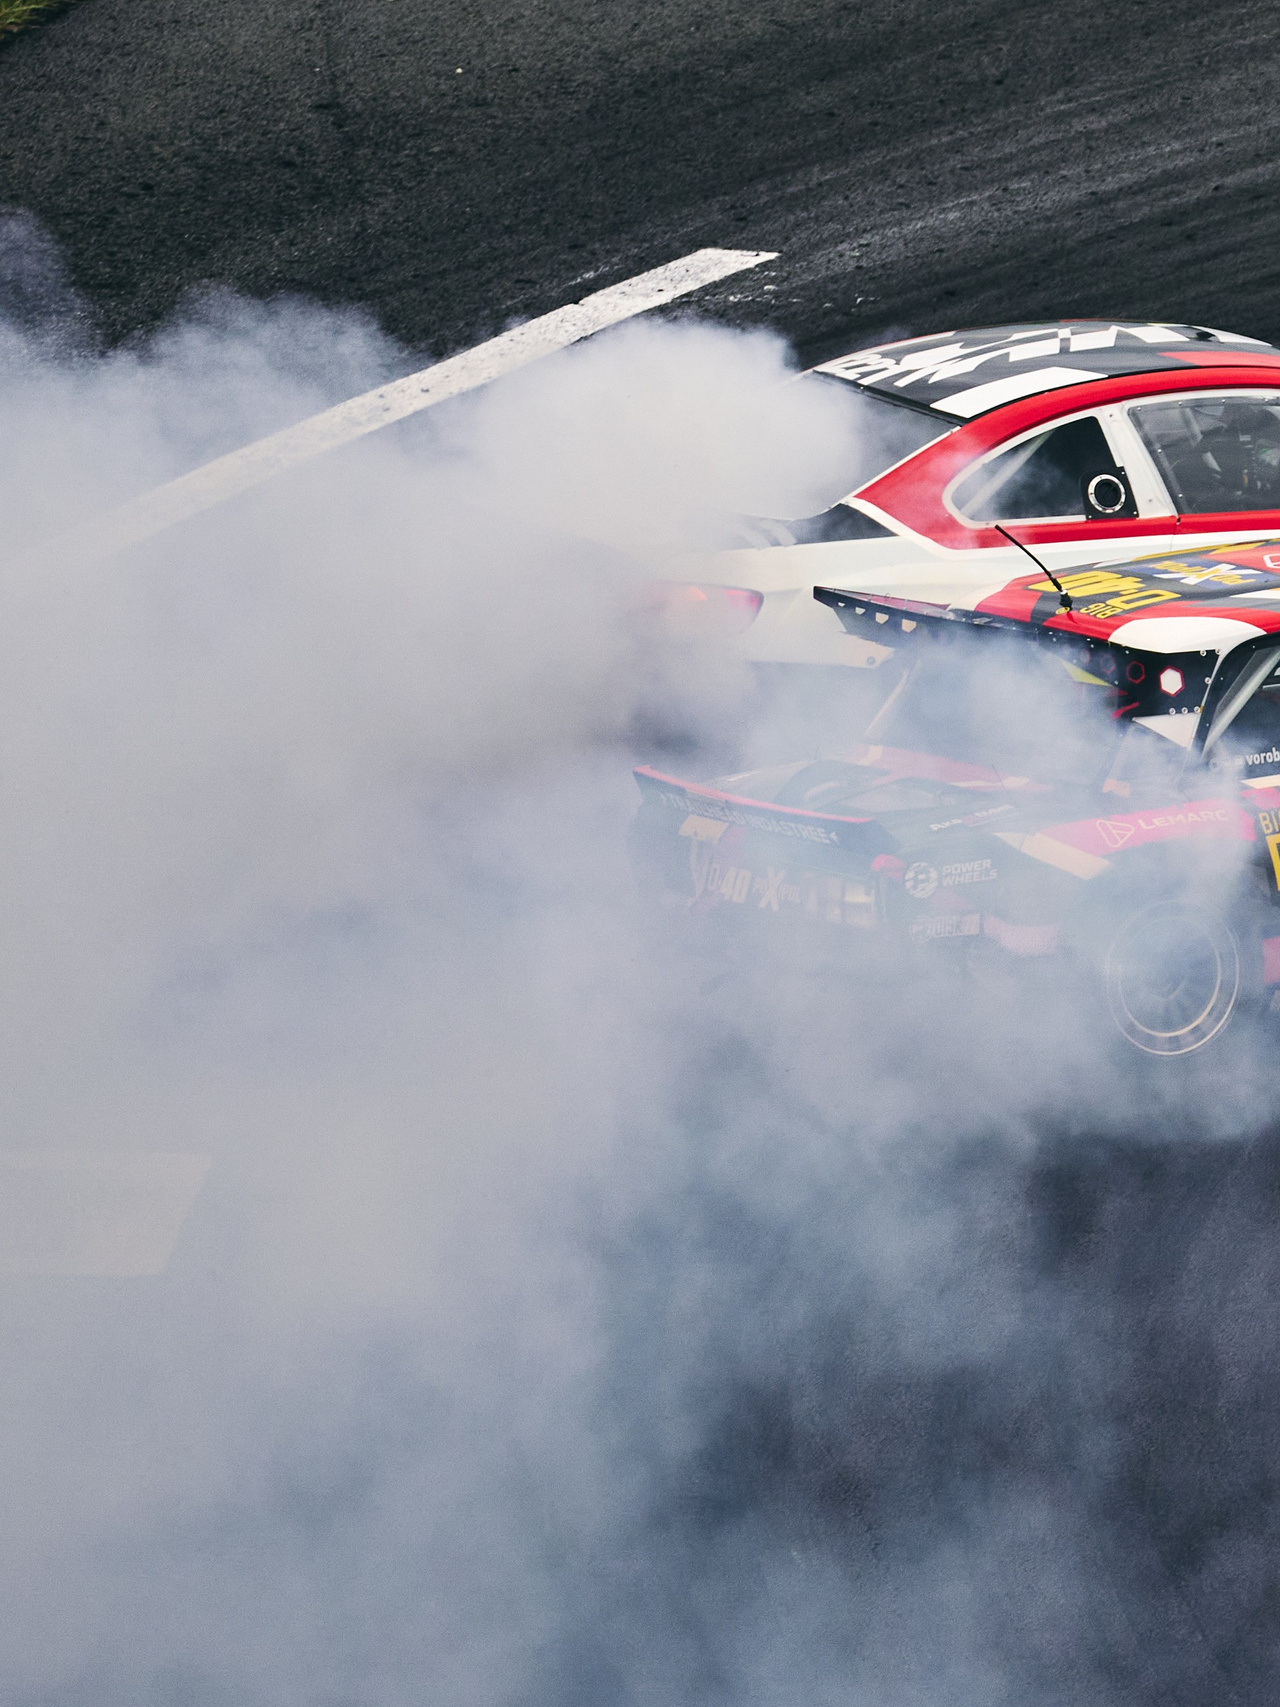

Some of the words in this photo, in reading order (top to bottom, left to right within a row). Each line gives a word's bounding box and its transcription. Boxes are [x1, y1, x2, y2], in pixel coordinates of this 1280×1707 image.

[1137, 809, 1229, 830] LEMARC
[942, 858, 993, 876] POWER
[942, 869, 999, 887] WHEELS
